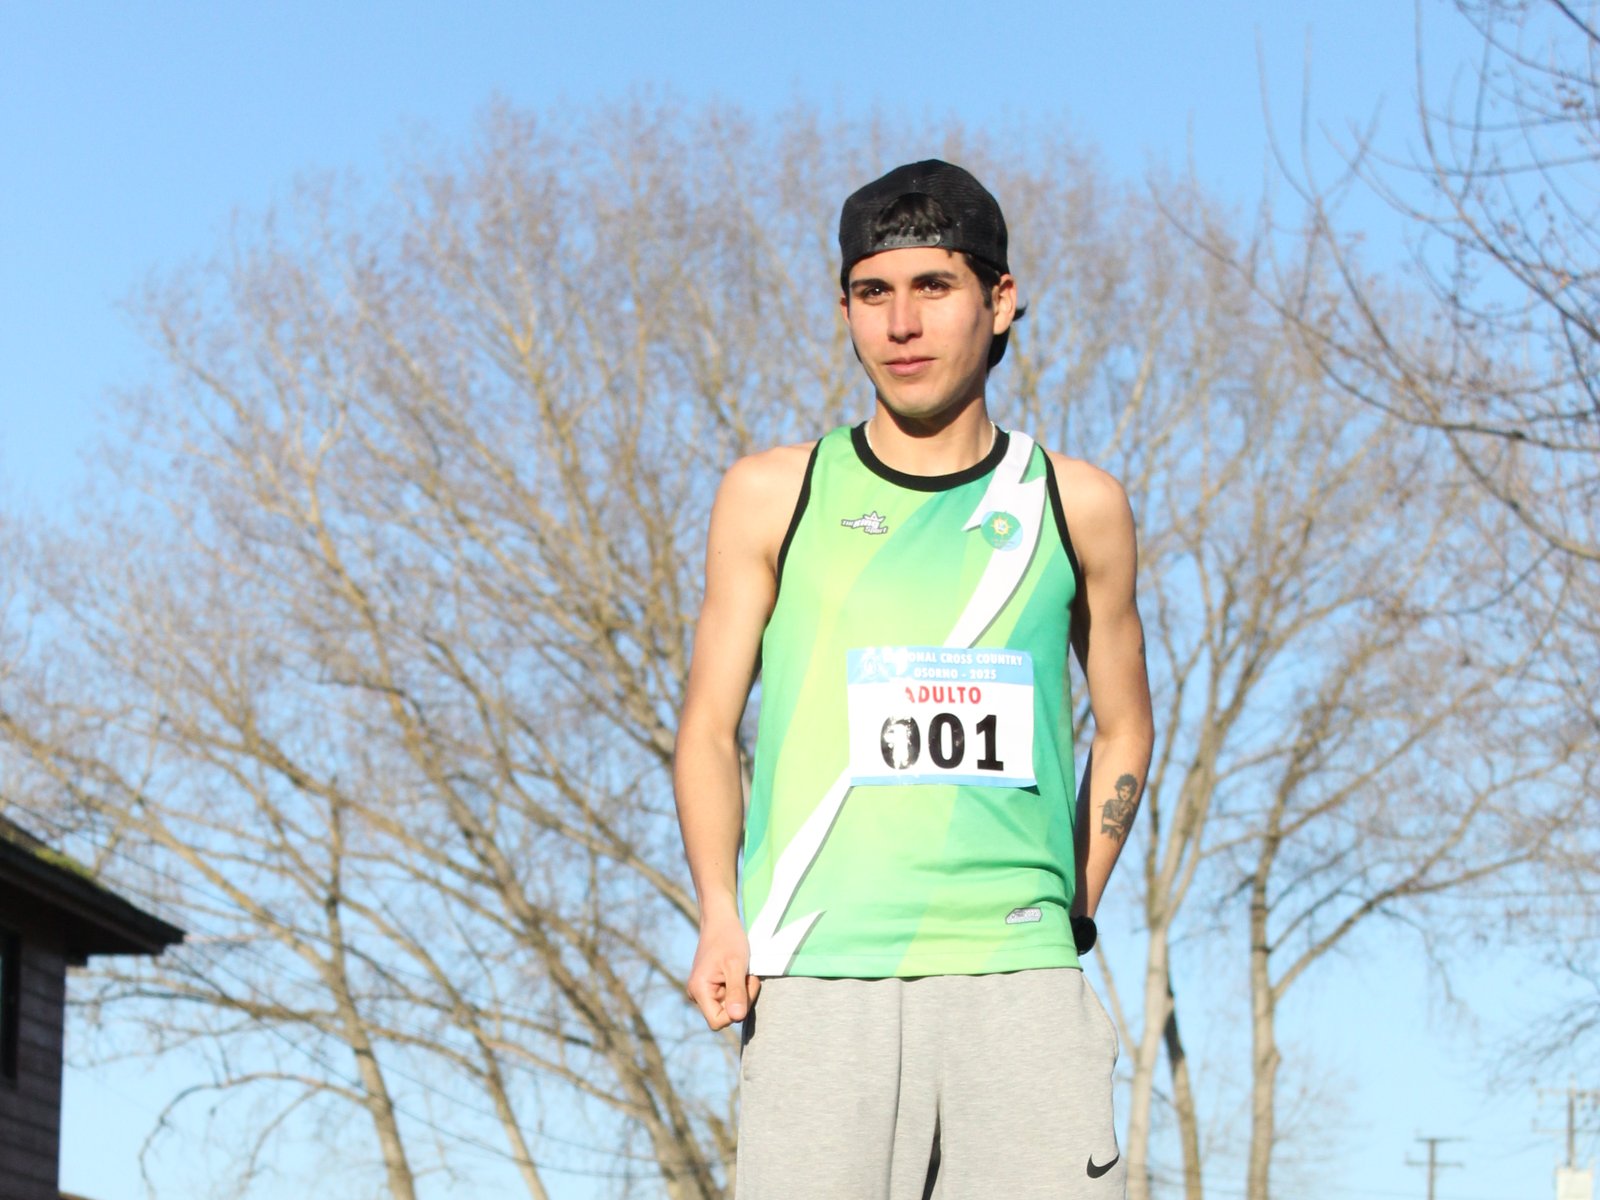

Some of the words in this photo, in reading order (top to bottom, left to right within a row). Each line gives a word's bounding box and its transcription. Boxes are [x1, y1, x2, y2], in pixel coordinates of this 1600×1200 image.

[941, 652, 973, 664] CROSS
[976, 653, 1022, 666] COUNTRY
[914, 667, 958, 679] OSORNO
[970, 669, 997, 679] 2025
[880, 713, 1004, 771] 001
